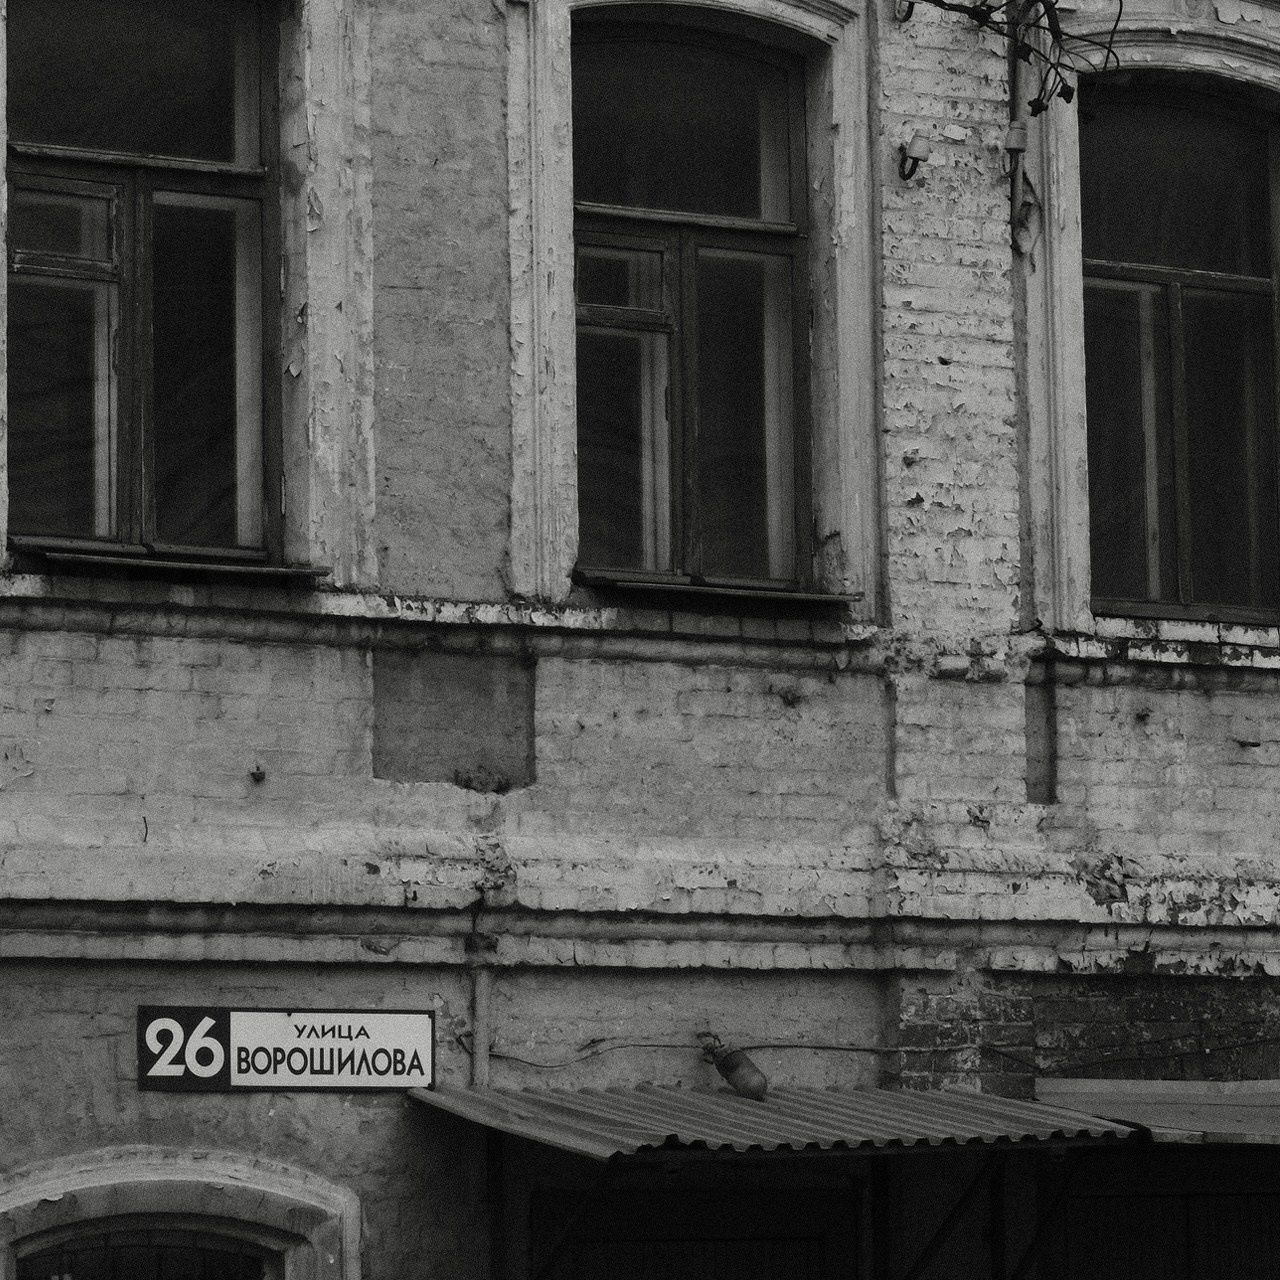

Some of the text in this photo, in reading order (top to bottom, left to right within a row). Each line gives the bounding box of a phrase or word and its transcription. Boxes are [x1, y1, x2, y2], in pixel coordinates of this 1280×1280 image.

[145, 1016, 225, 1078] 26
[294, 1024, 370, 1041] УЛИЦА
[237, 1046, 425, 1076] ВОРОШИЛОВА
